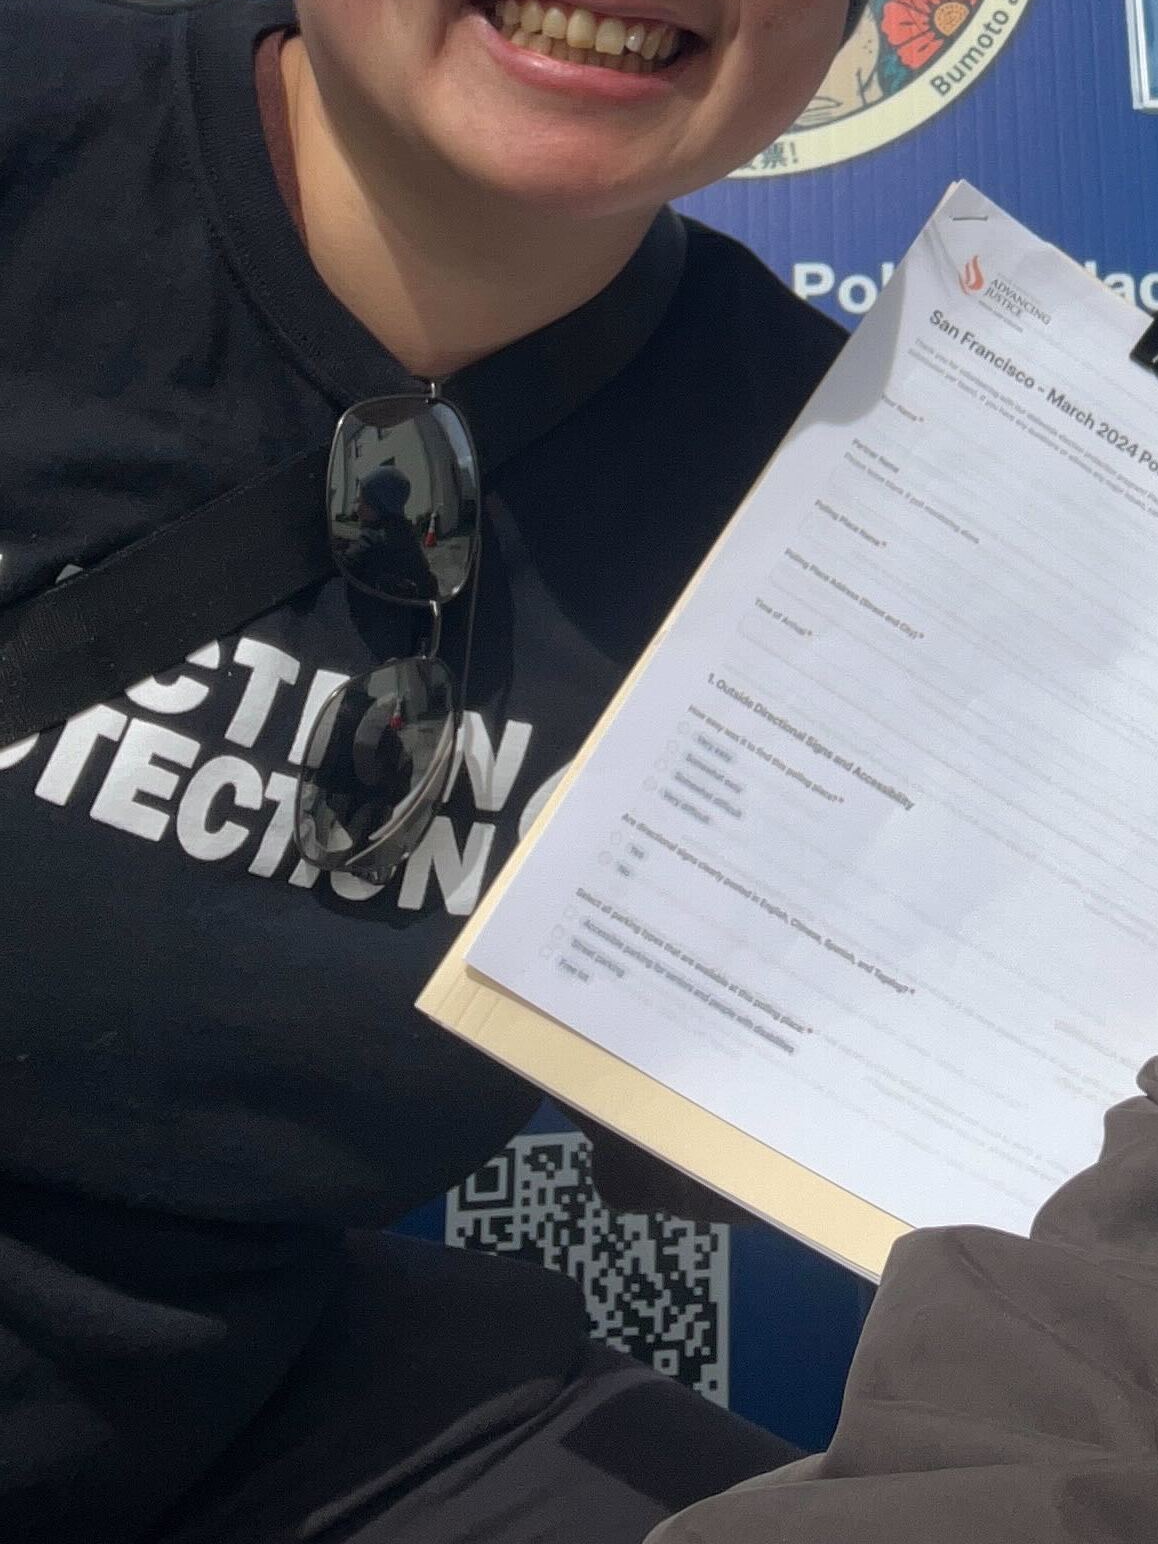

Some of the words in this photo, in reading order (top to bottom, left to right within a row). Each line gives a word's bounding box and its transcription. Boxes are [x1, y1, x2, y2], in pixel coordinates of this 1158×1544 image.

[930, 9, 1009, 98] Bumoto
[983, 286, 1022, 317] JUSTICE
[989, 277, 1051, 325] ADVANCING
[929, 309, 960, 340] San
[959, 330, 1036, 389] Francisco
[1046, 387, 1096, 430] March
[1095, 421, 1139, 458] 2024
[715, 679, 754, 709] Outside
[753, 702, 808, 742] Directional
[804, 735, 834, 760] Signs
[832, 755, 854, 772] and
[851, 766, 915, 812] Accessibility
